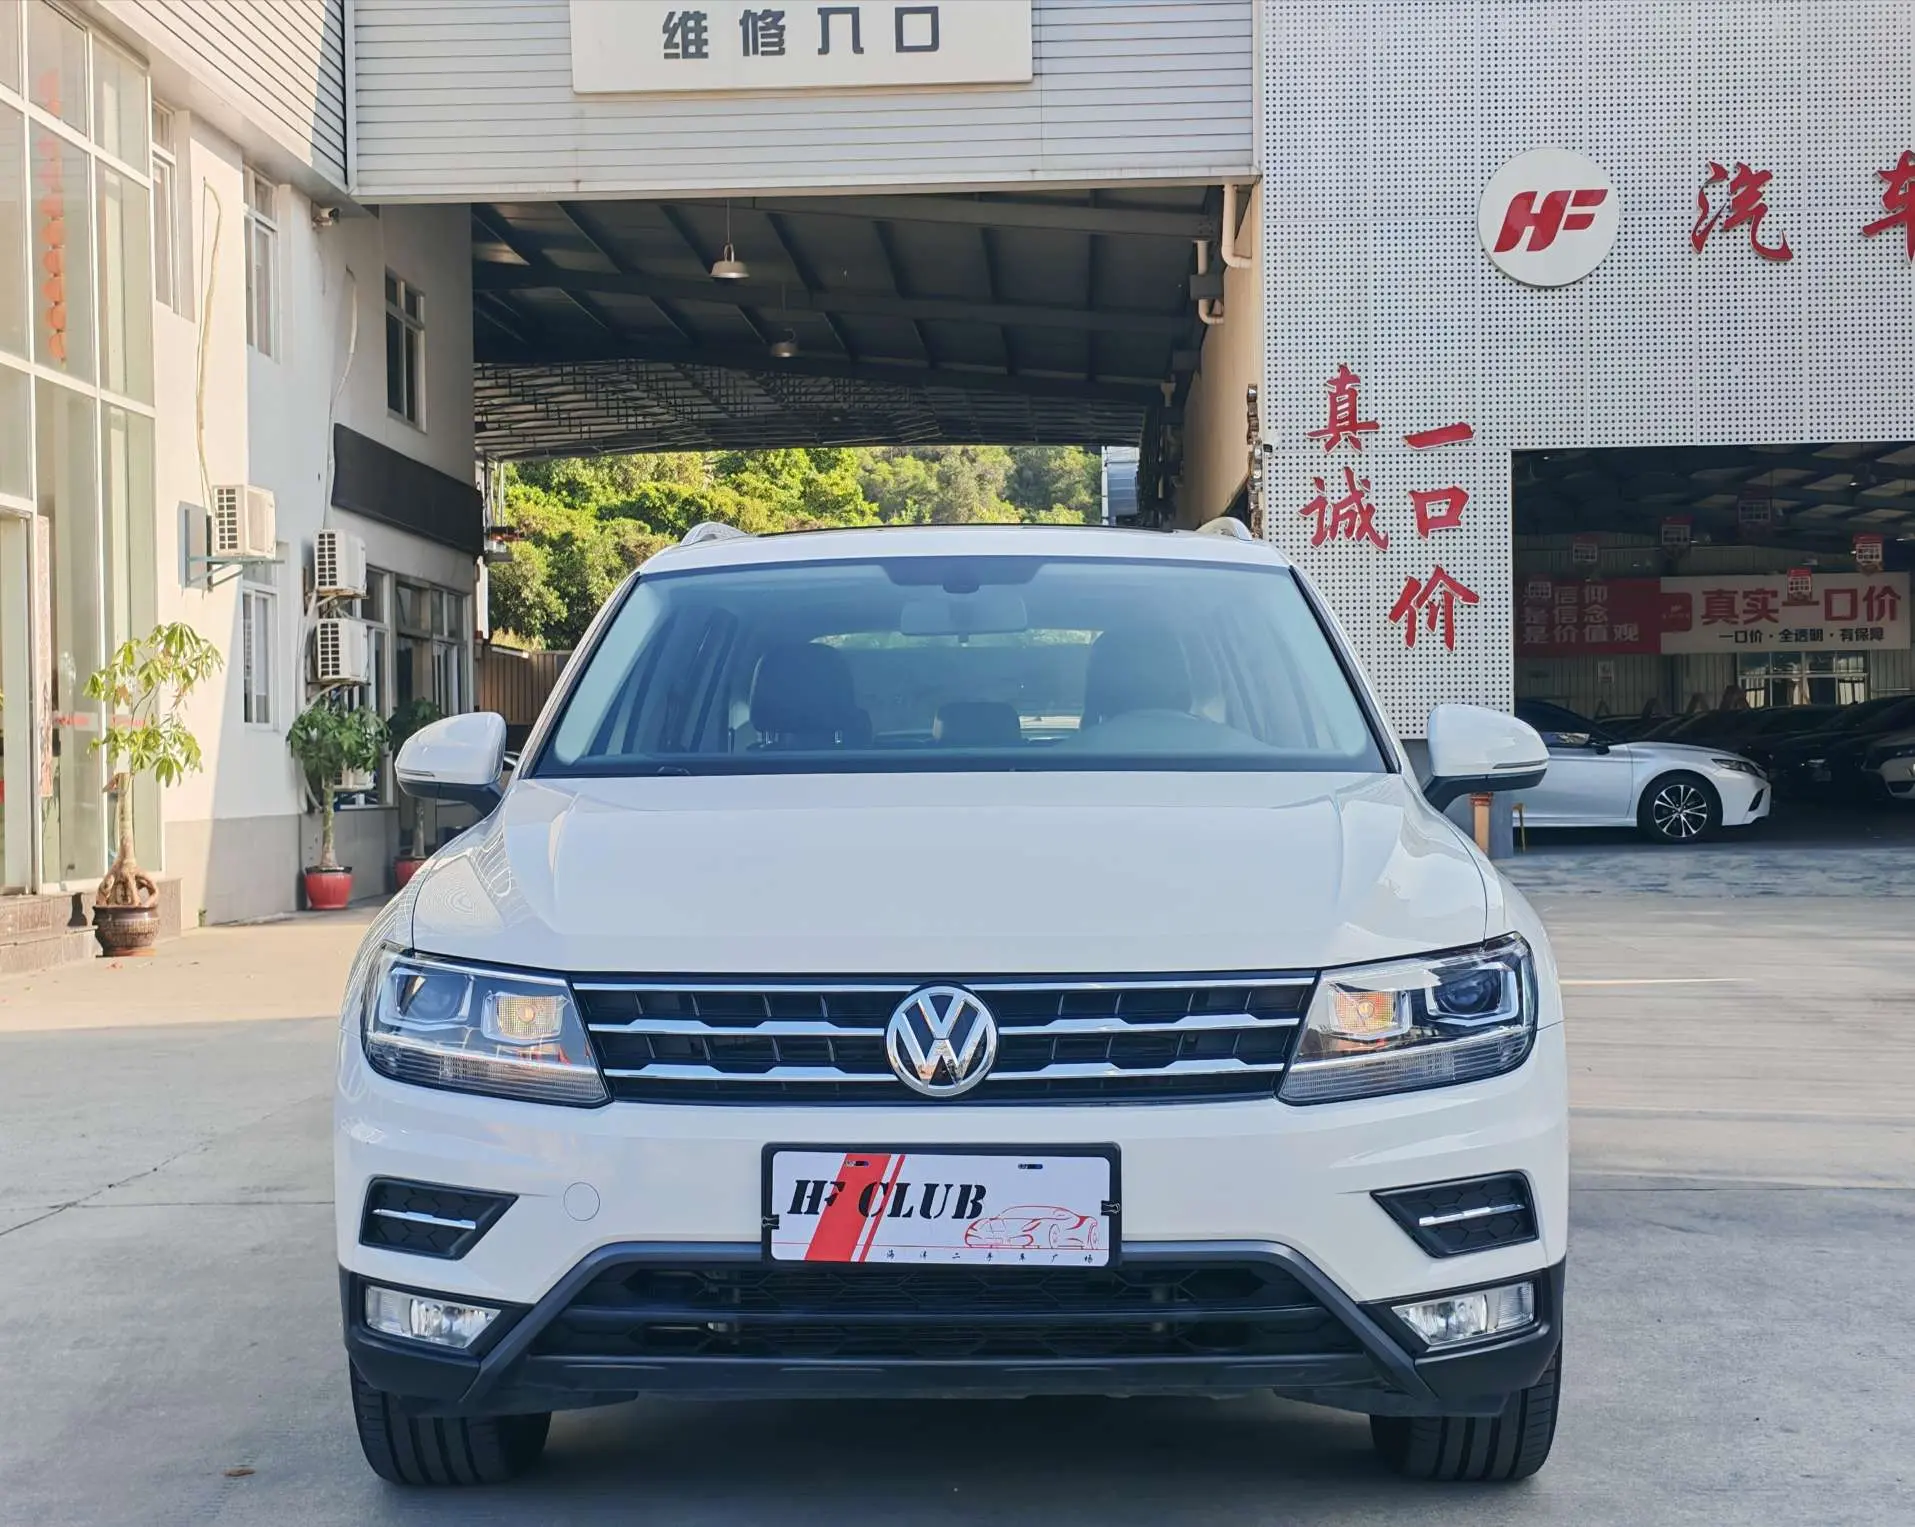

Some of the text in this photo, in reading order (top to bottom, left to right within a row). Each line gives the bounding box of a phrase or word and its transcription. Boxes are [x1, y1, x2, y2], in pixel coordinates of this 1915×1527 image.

[662, 6, 940, 60] 维修入口
[1493, 188, 1608, 253] HF
[1299, 363, 1390, 551] 真诚
[1388, 421, 1480, 652] 一口价
[1701, 585, 1902, 626] 真实一口价
[787, 1179, 987, 1220] HF CLUB
